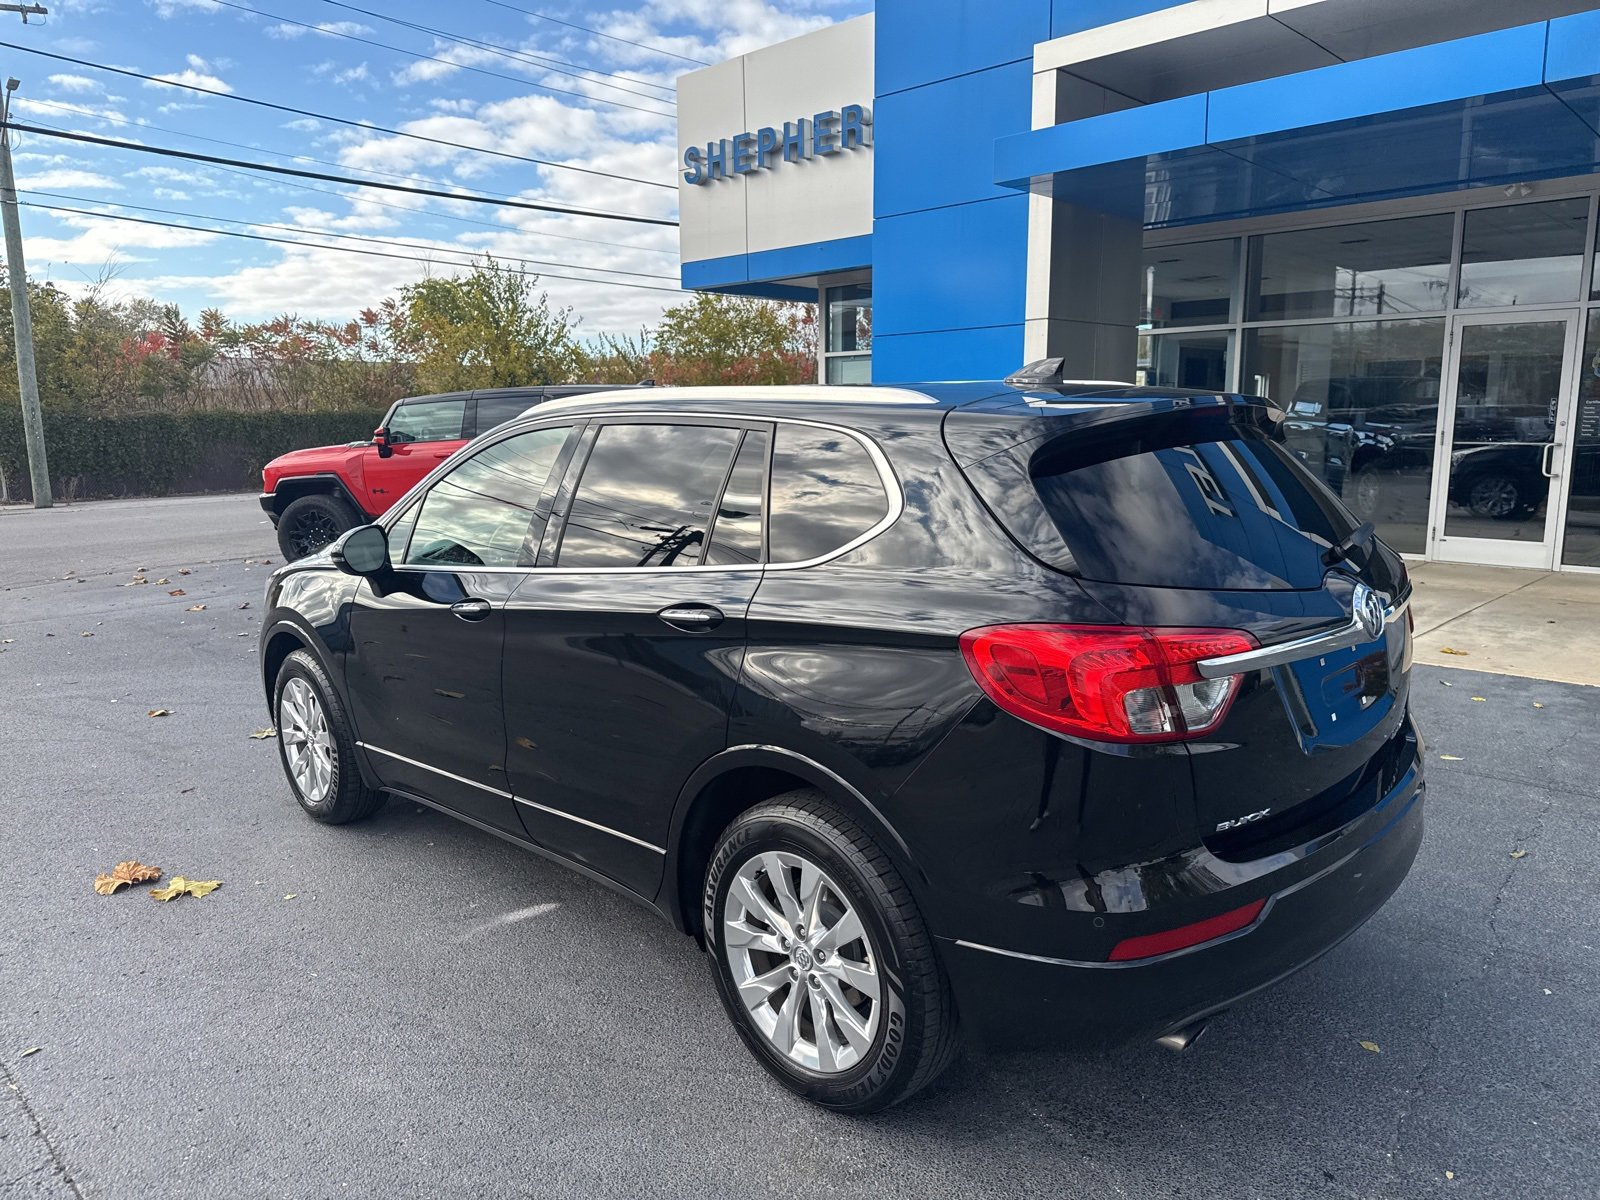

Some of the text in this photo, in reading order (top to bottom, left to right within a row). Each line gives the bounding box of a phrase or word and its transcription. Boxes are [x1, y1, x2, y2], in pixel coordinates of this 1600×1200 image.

[684, 103, 873, 186] SHEPHER
[1216, 808, 1271, 832] BUICK
[704, 827, 752, 921] ASSURANCE
